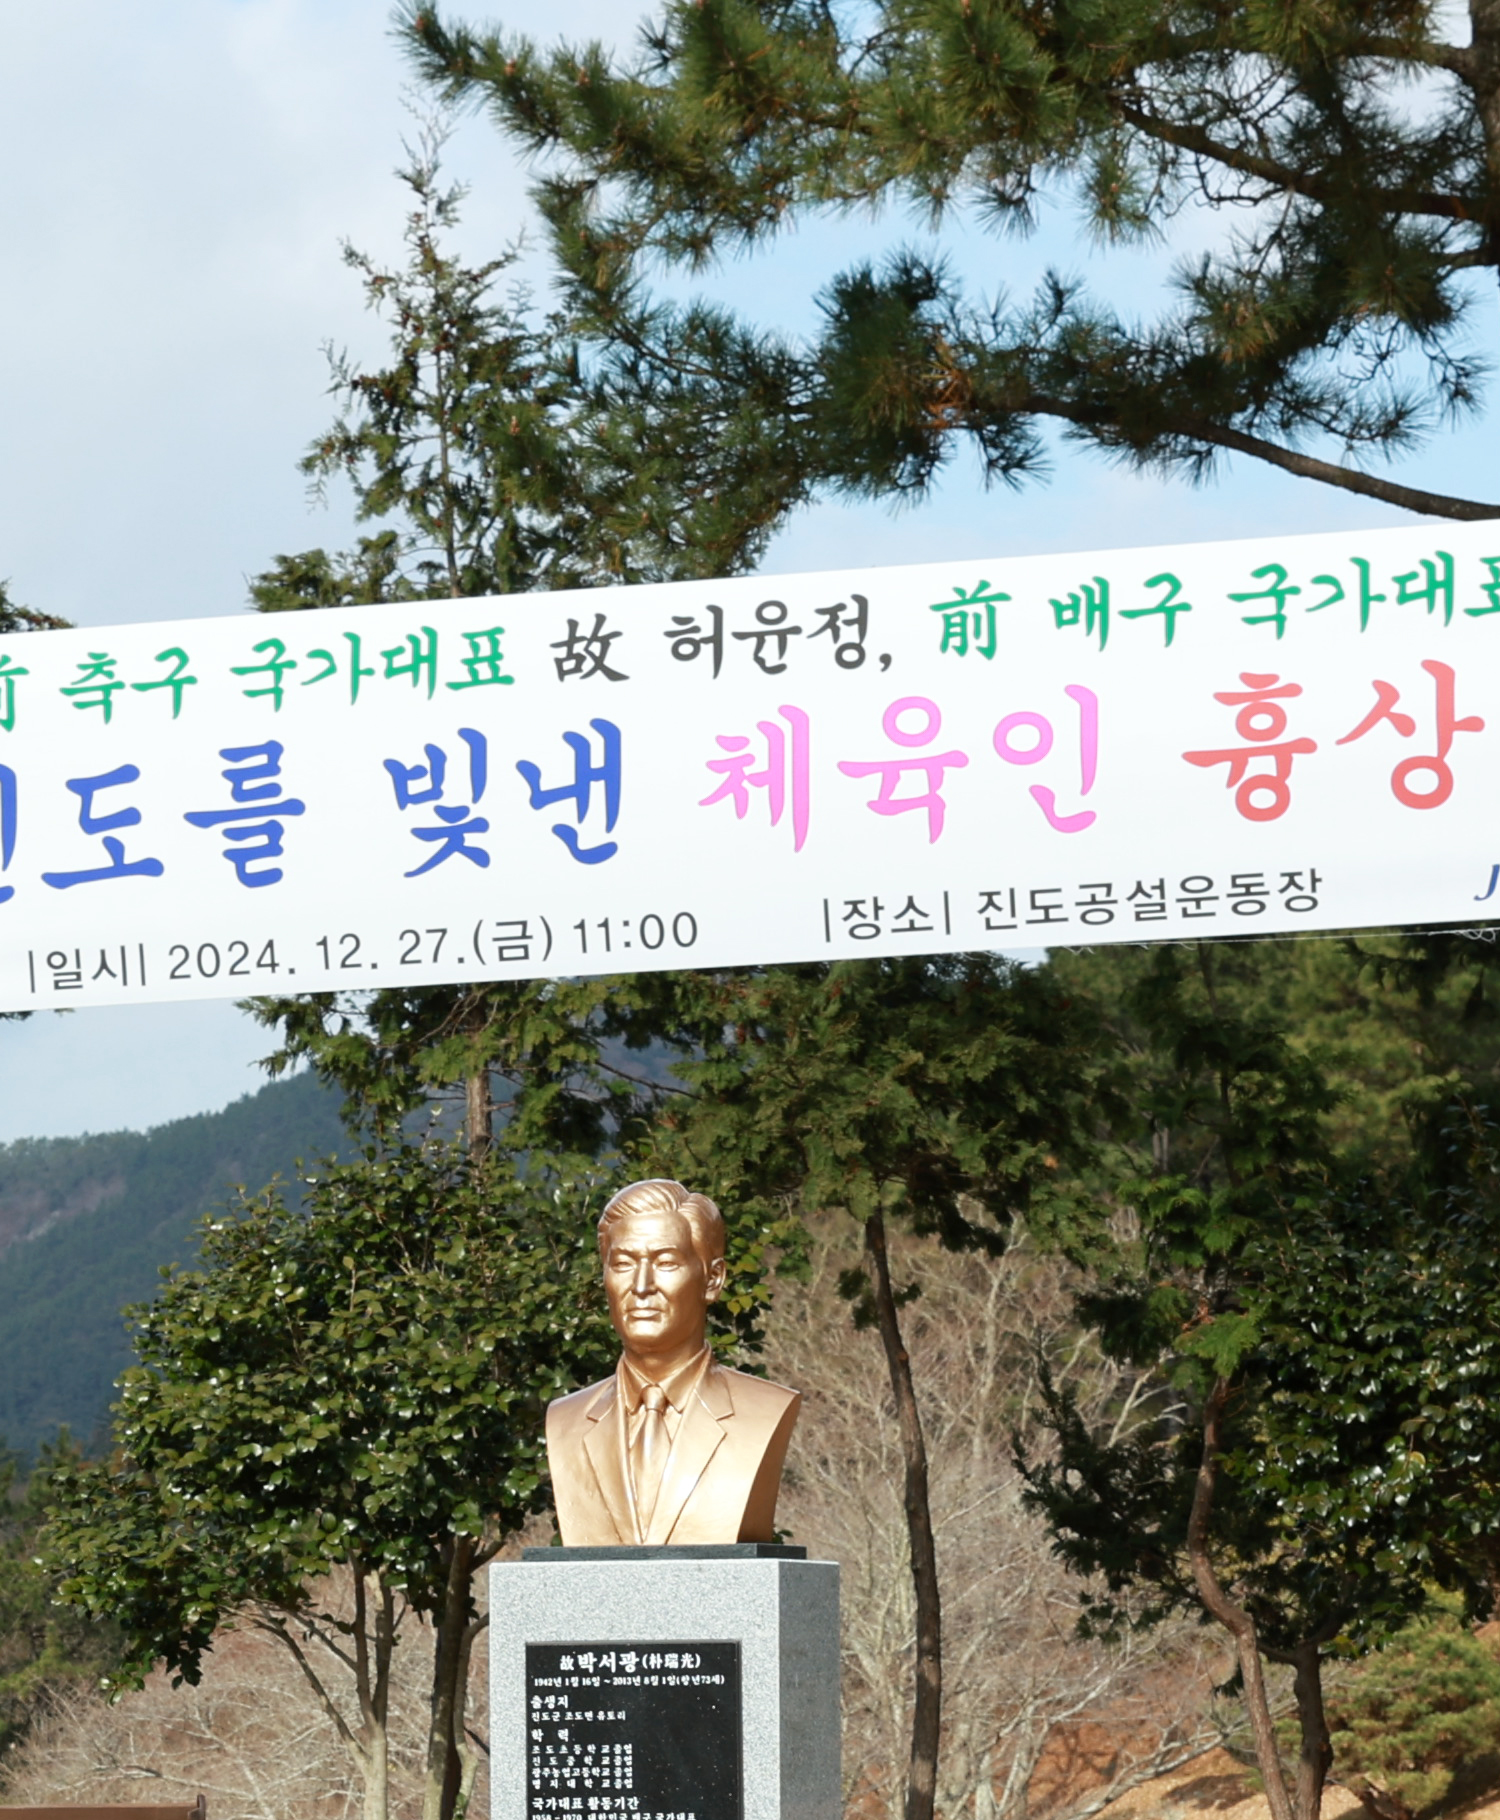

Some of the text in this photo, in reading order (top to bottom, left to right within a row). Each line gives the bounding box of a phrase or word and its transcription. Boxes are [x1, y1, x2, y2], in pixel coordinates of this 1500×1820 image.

[61, 648, 197, 723] 축구
[232, 626, 514, 711] 국가대표
[550, 614, 629, 681] 故
[664, 595, 891, 678] 허윤정,
[931, 580, 1011, 659] 前
[1050, 573, 1192, 649] 배구
[384, 718, 621, 877] 빛낸
[700, 685, 1097, 851] 체육인
[1183, 660, 1484, 821] 흉상
[978, 869, 1322, 930] 진도공설운동장
[170, 940, 295, 979] 2024.
[317, 934, 377, 969] 12.
[574, 912, 697, 953] 11:00
[531, 1695, 568, 1709] 출생지
[532, 1711, 560, 1722] 진도군
[532, 1796, 639, 1810] 국가대표 활동기간
